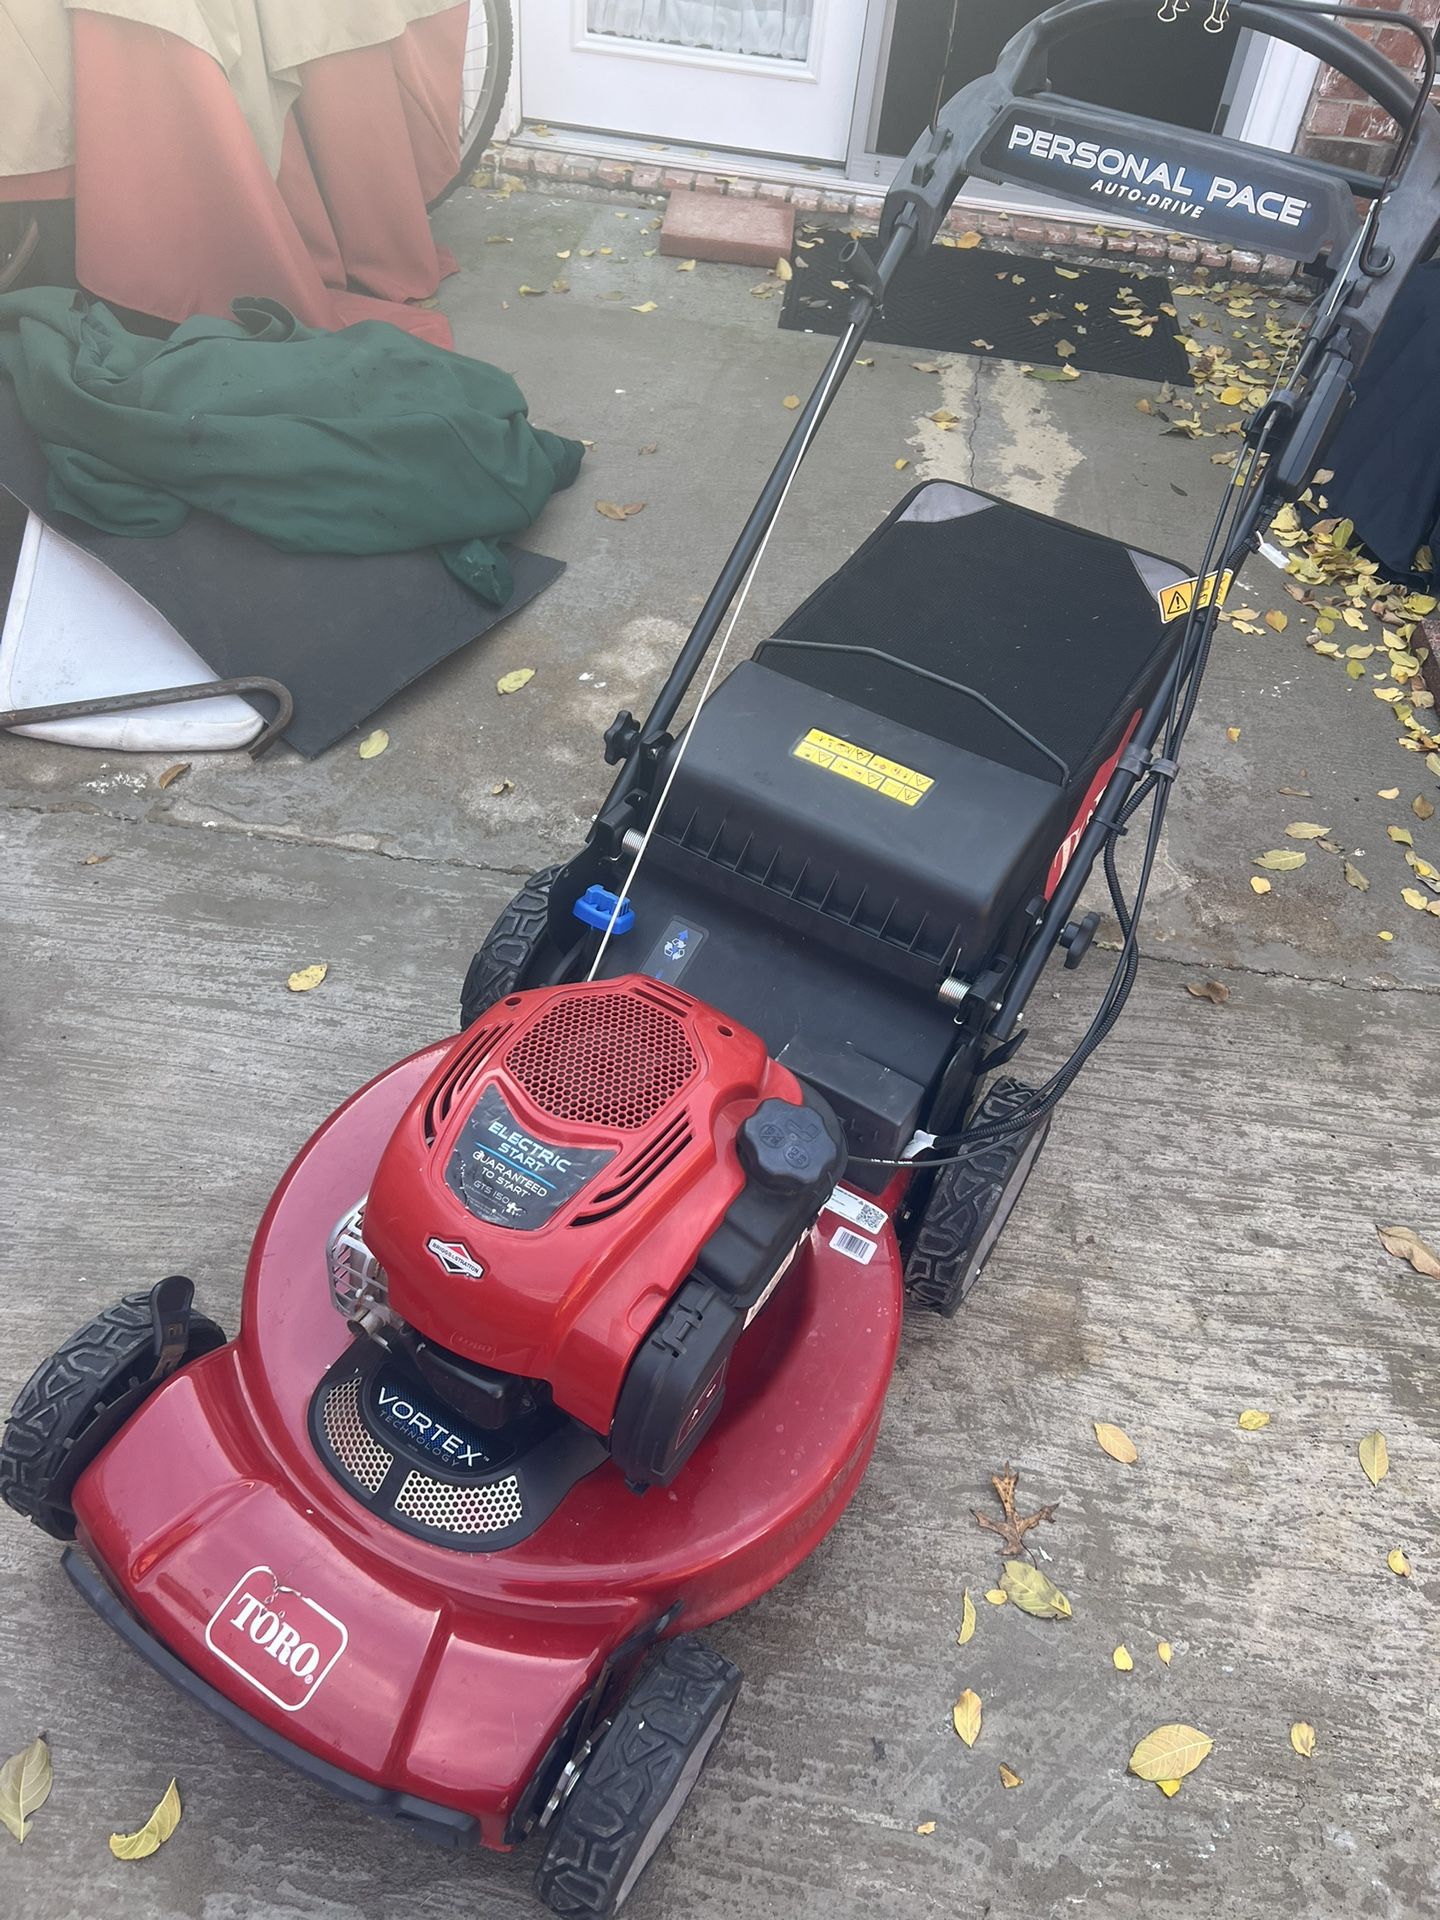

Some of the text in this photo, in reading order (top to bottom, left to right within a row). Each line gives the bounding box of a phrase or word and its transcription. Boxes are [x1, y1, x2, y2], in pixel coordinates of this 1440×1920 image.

[1007, 124, 1308, 227] PERSONAL PACE
[1090, 179, 1206, 219] AUTO-DRIVE
[488, 1121, 571, 1173] ELECTRIC
[497, 1143, 545, 1173] START
[472, 1150, 548, 1197] GUARANTEED
[473, 1180, 492, 1195] GTS
[481, 1166, 530, 1198] TO START
[378, 1386, 483, 1468] VORTEX
[379, 1409, 460, 1468] TECHNOLOGY
[229, 1591, 321, 1677] TORO
